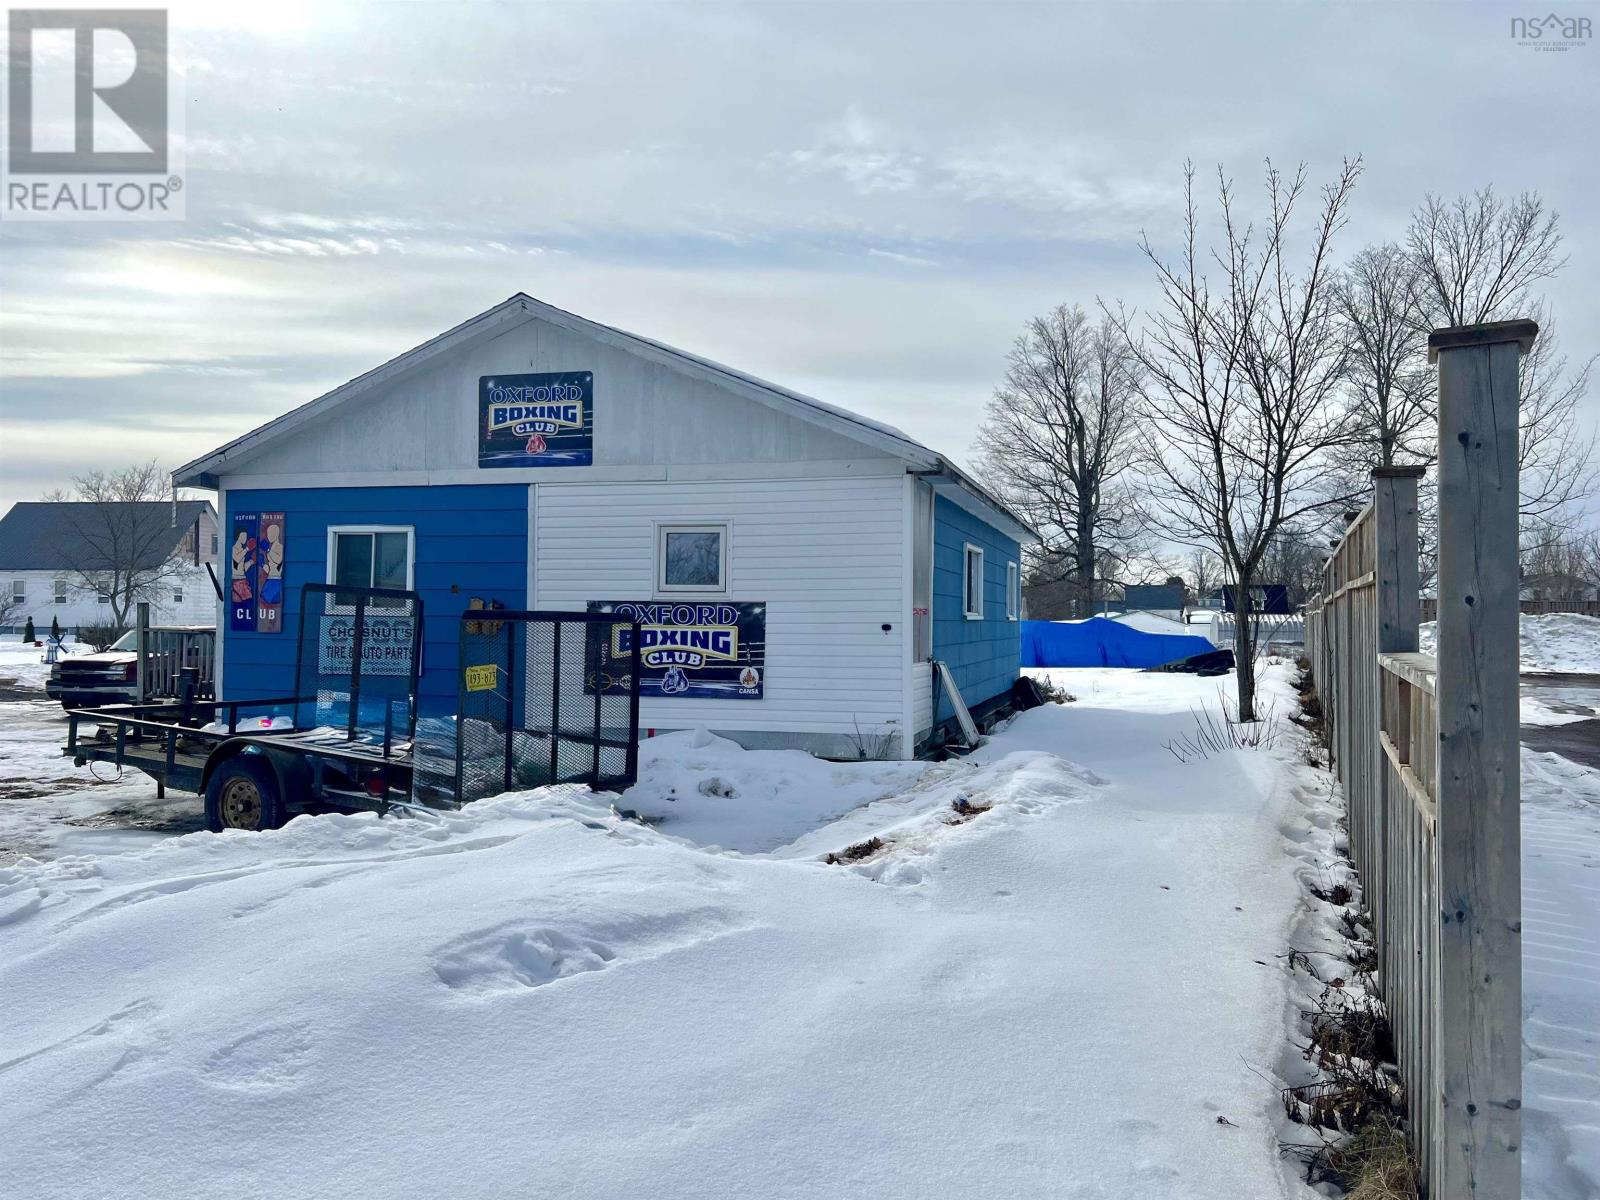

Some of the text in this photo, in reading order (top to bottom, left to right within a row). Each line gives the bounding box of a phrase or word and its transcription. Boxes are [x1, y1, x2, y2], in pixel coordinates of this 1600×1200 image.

[489, 386, 583, 404] OXFORD
[493, 405, 577, 426] BOXING
[515, 423, 556, 433] CLUB
[614, 603, 738, 626] OXFORD
[328, 628, 413, 638] CHOSNUT'S
[619, 629, 731, 656] BOXING
[326, 646, 346, 659] TIRE
[361, 647, 382, 659] UTO
[648, 650, 701, 666] CLUB
